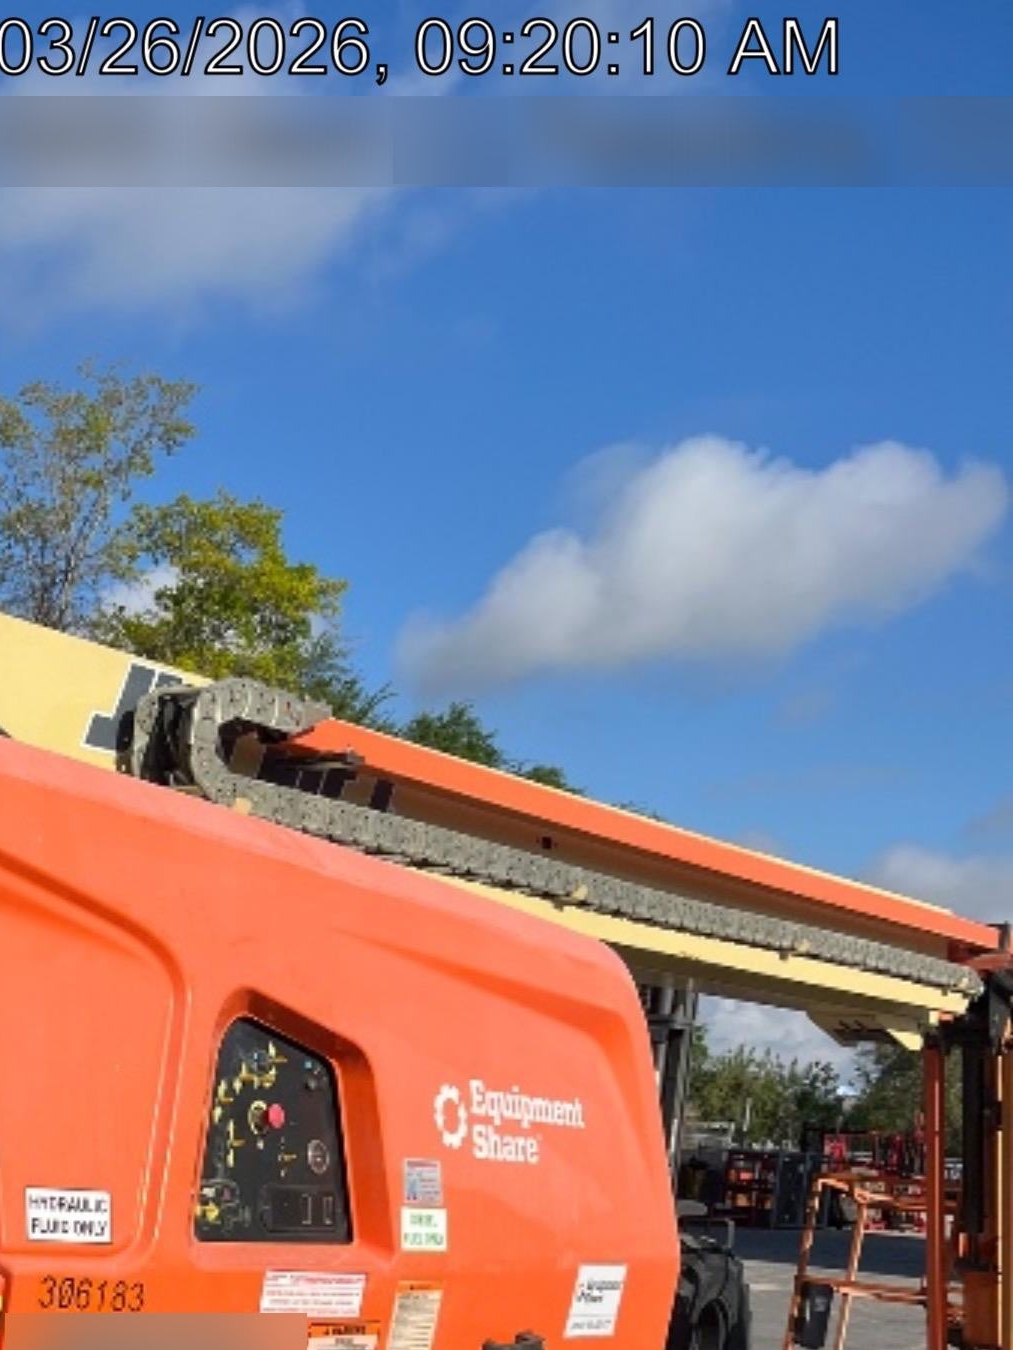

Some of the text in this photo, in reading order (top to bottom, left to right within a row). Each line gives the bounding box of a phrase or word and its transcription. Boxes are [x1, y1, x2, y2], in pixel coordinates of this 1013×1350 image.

[469, 1079, 586, 1129] Equipment
[473, 1124, 539, 1164] Share
[29, 1195, 108, 1214] HYDRAULIC
[31, 1217, 69, 1235] FLUID
[38, 1274, 144, 1312] 306183
